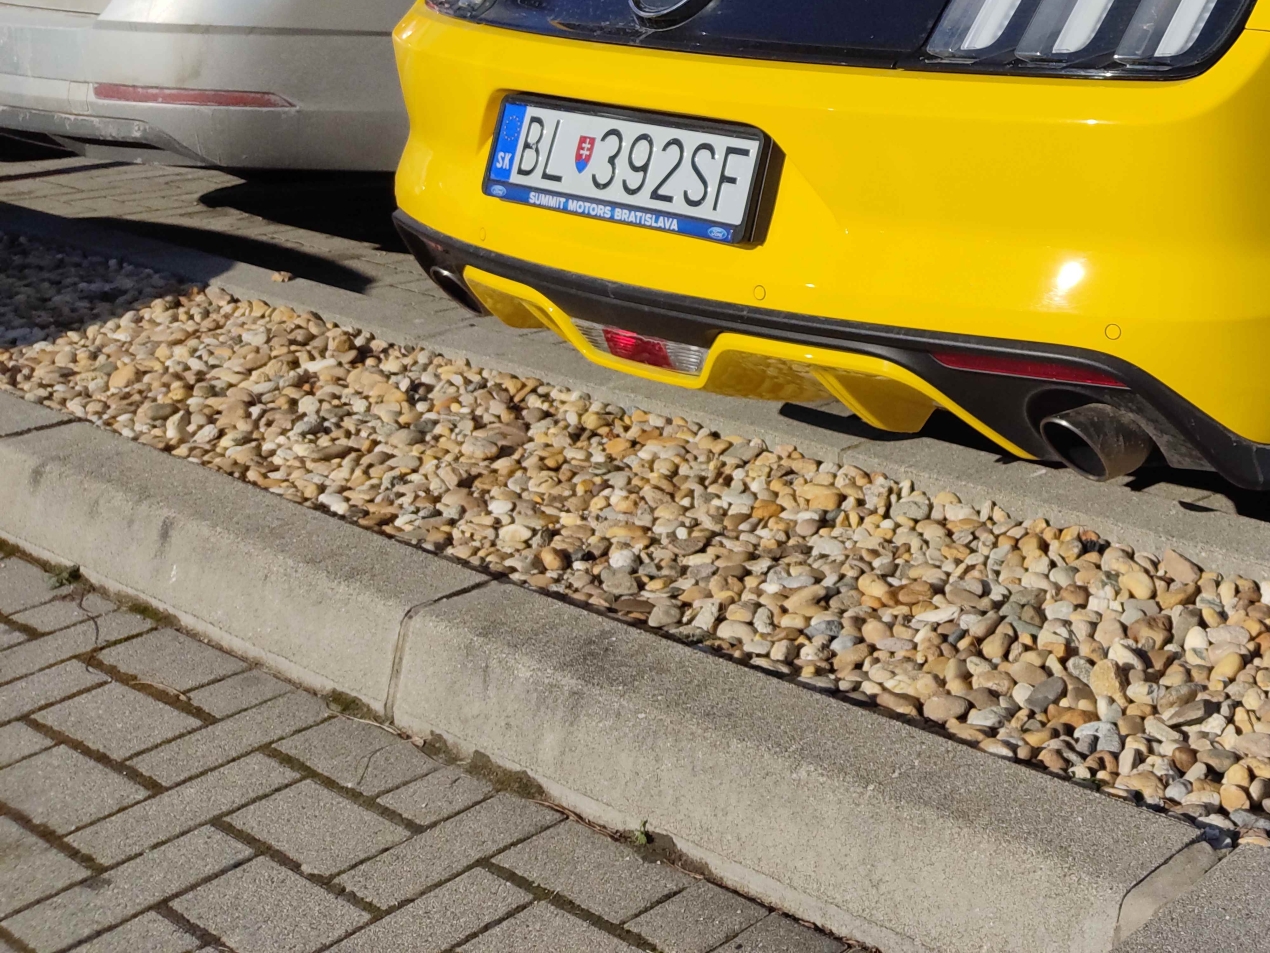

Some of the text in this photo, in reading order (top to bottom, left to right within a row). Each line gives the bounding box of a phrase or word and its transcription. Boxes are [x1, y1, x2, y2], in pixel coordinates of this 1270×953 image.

[495, 151, 512, 170] SK
[516, 115, 751, 211] BL 392SF
[528, 192, 679, 231] SUMMIT MOTORS BRATISLAVA
